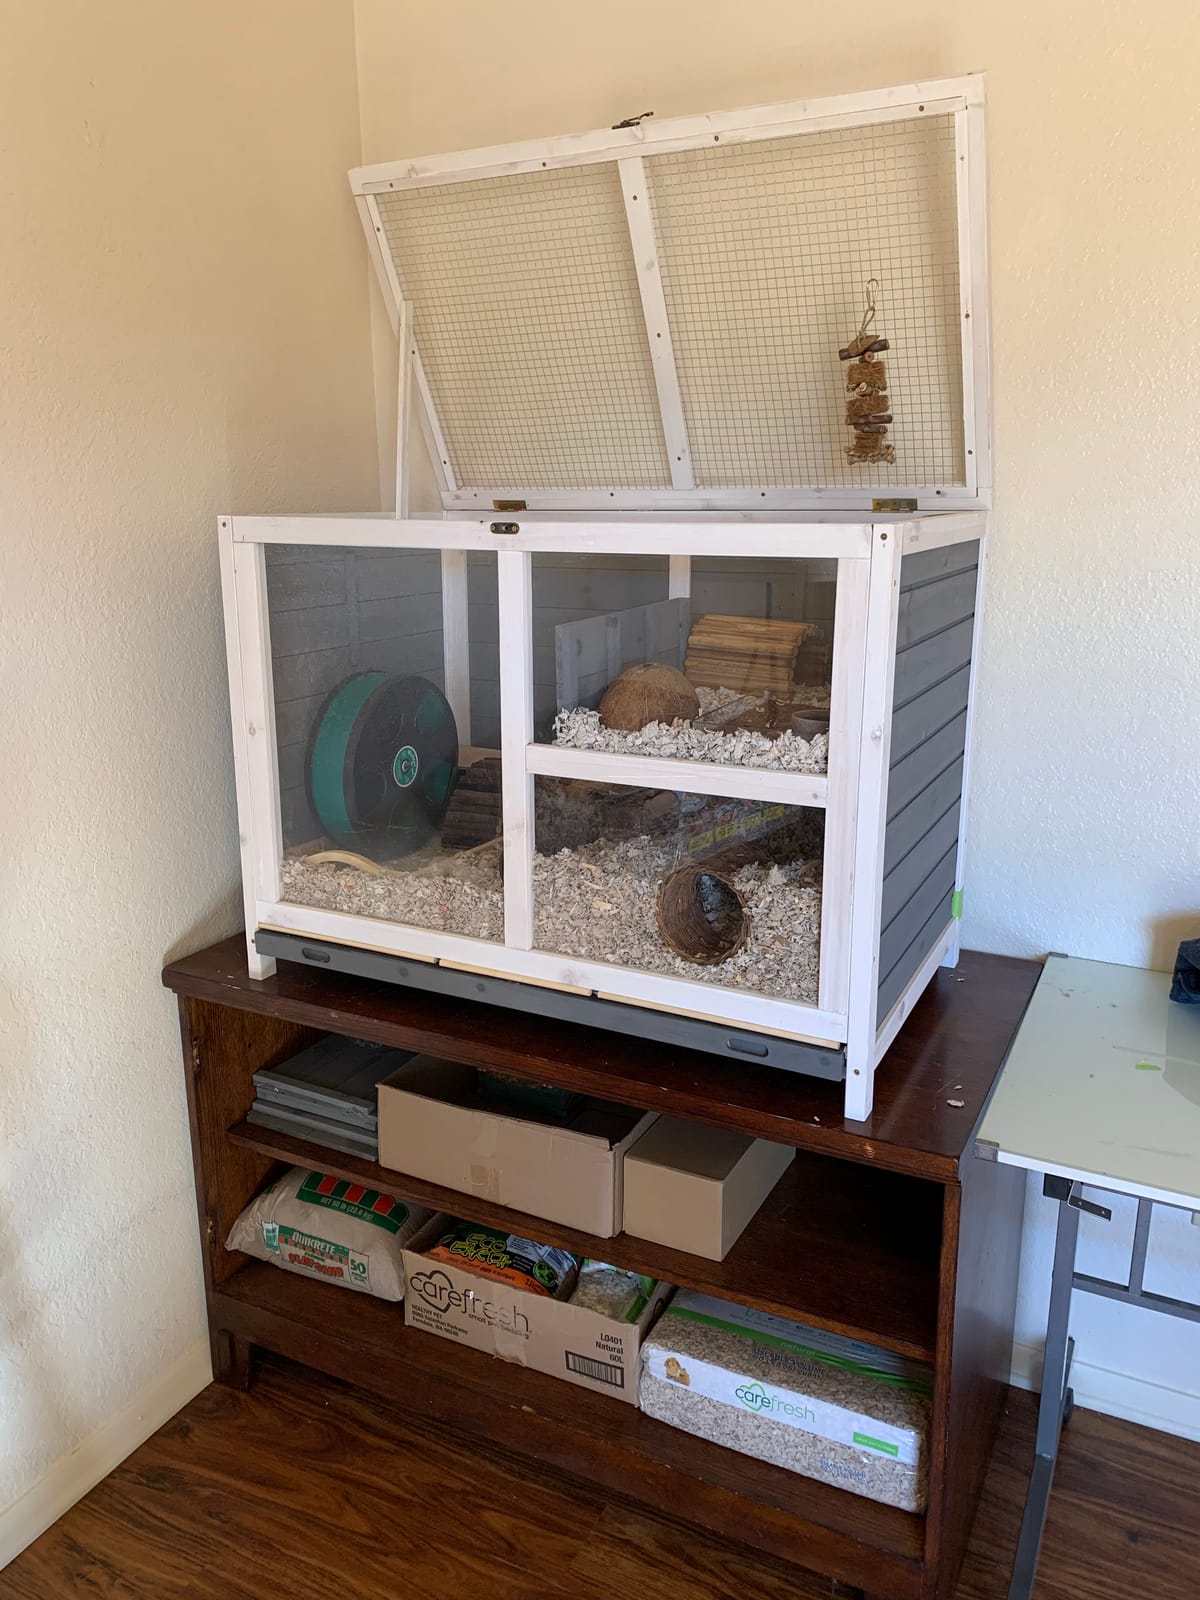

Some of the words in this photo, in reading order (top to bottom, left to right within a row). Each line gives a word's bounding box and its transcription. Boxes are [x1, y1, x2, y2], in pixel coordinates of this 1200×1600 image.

[292, 1231, 336, 1255] QUIKRETE
[350, 1258, 367, 1276] 50
[409, 1276, 530, 1334] carefresh
[595, 1340, 624, 1355] Natural
[609, 1353, 625, 1364] 60L
[735, 1388, 816, 1423] carefresh
